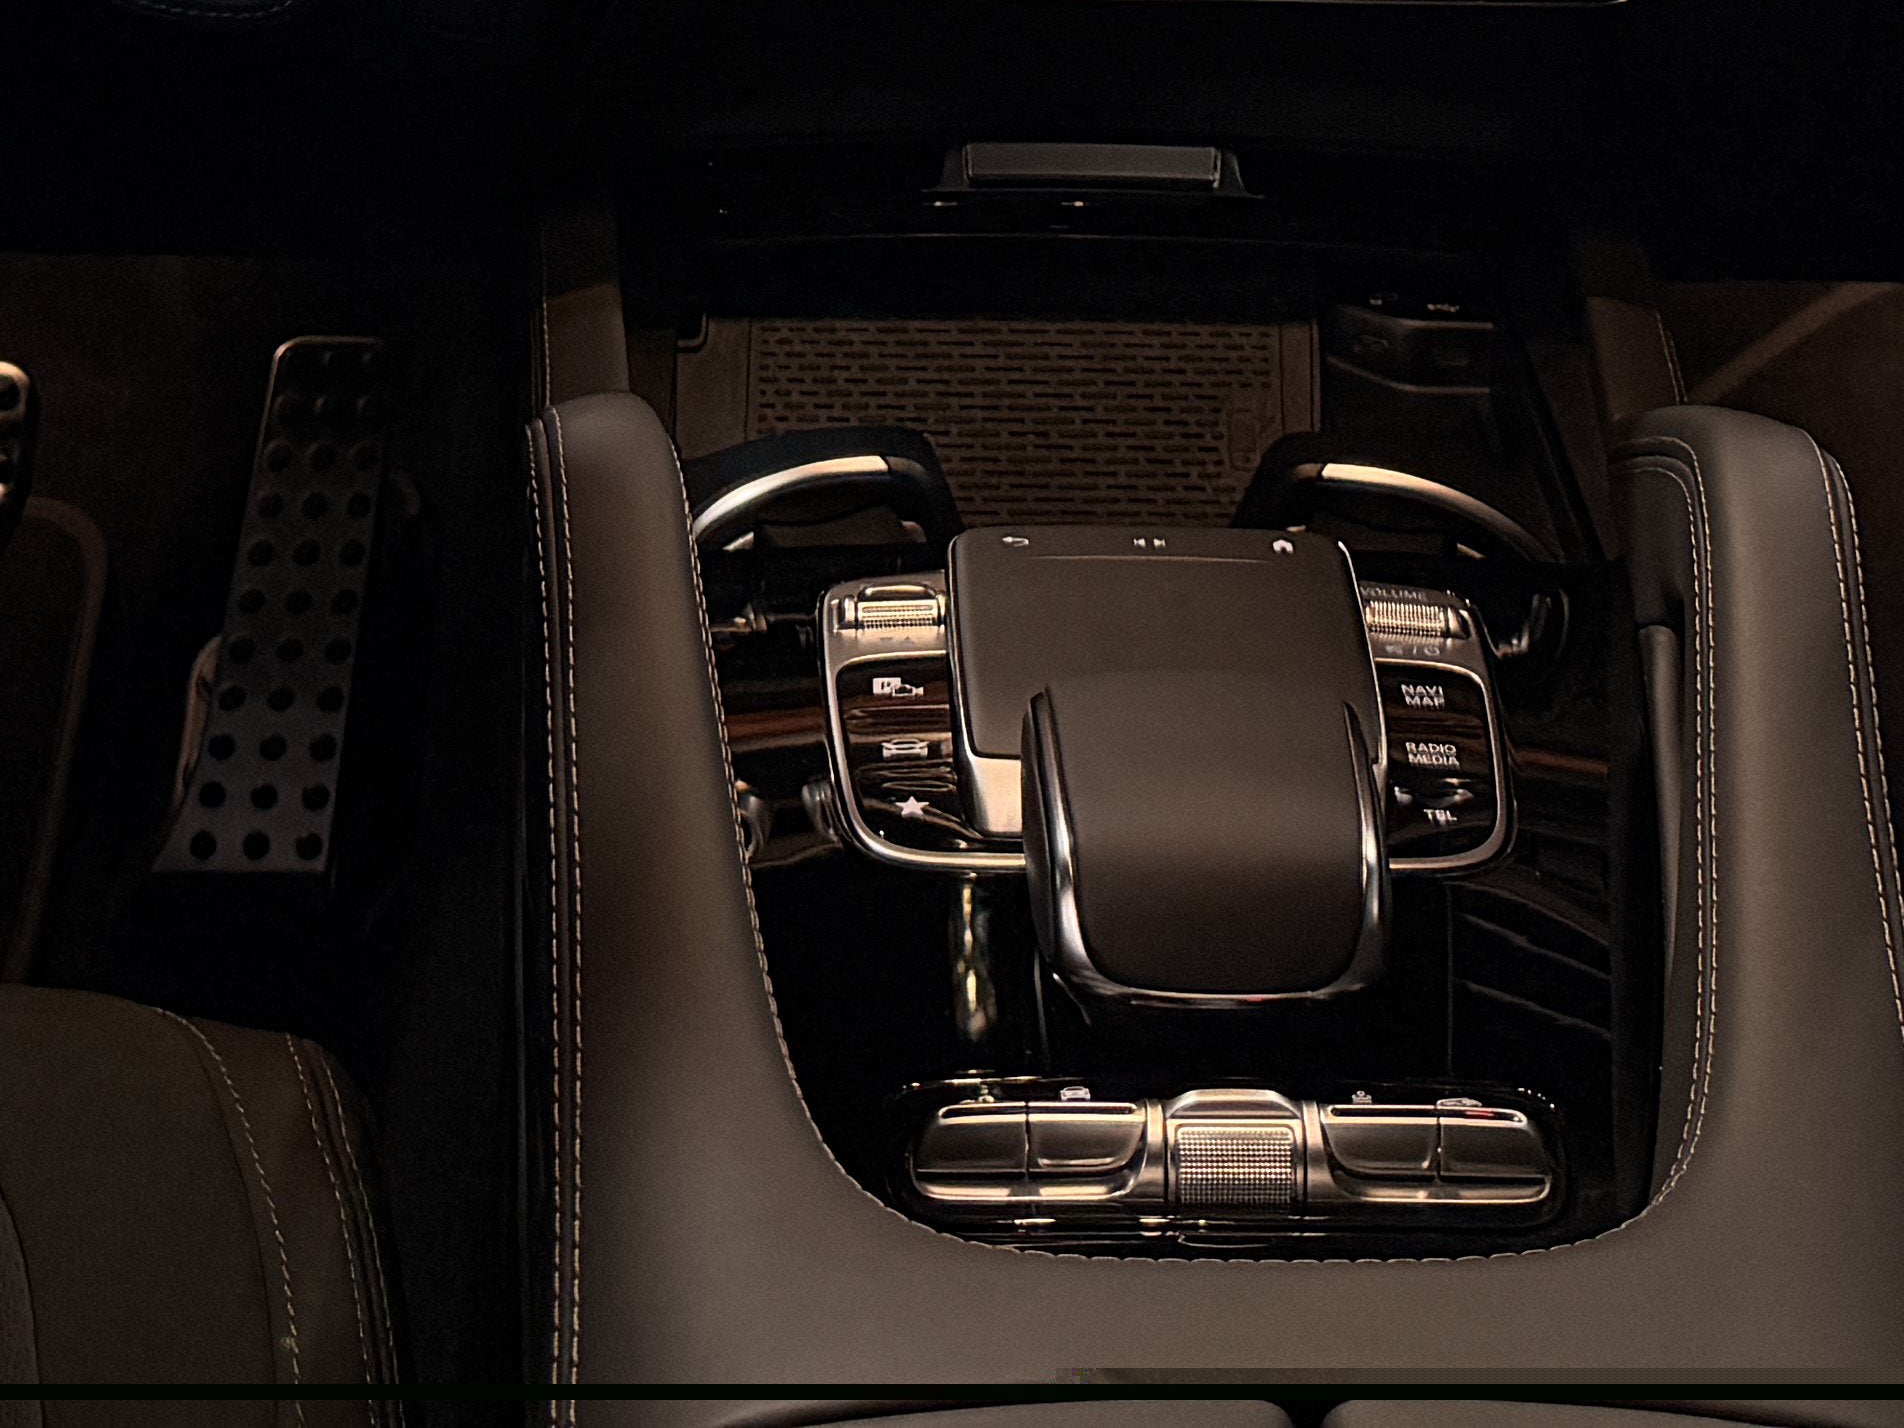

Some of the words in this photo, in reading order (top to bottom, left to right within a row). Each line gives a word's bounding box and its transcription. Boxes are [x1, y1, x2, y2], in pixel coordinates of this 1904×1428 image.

[1360, 587, 1428, 601] VOLUME
[1401, 683, 1444, 697] NAVI
[1405, 694, 1446, 707] MAP
[1406, 741, 1457, 755] RADIO
[1408, 752, 1460, 766] MEDIA
[1424, 809, 1458, 822] TEL
